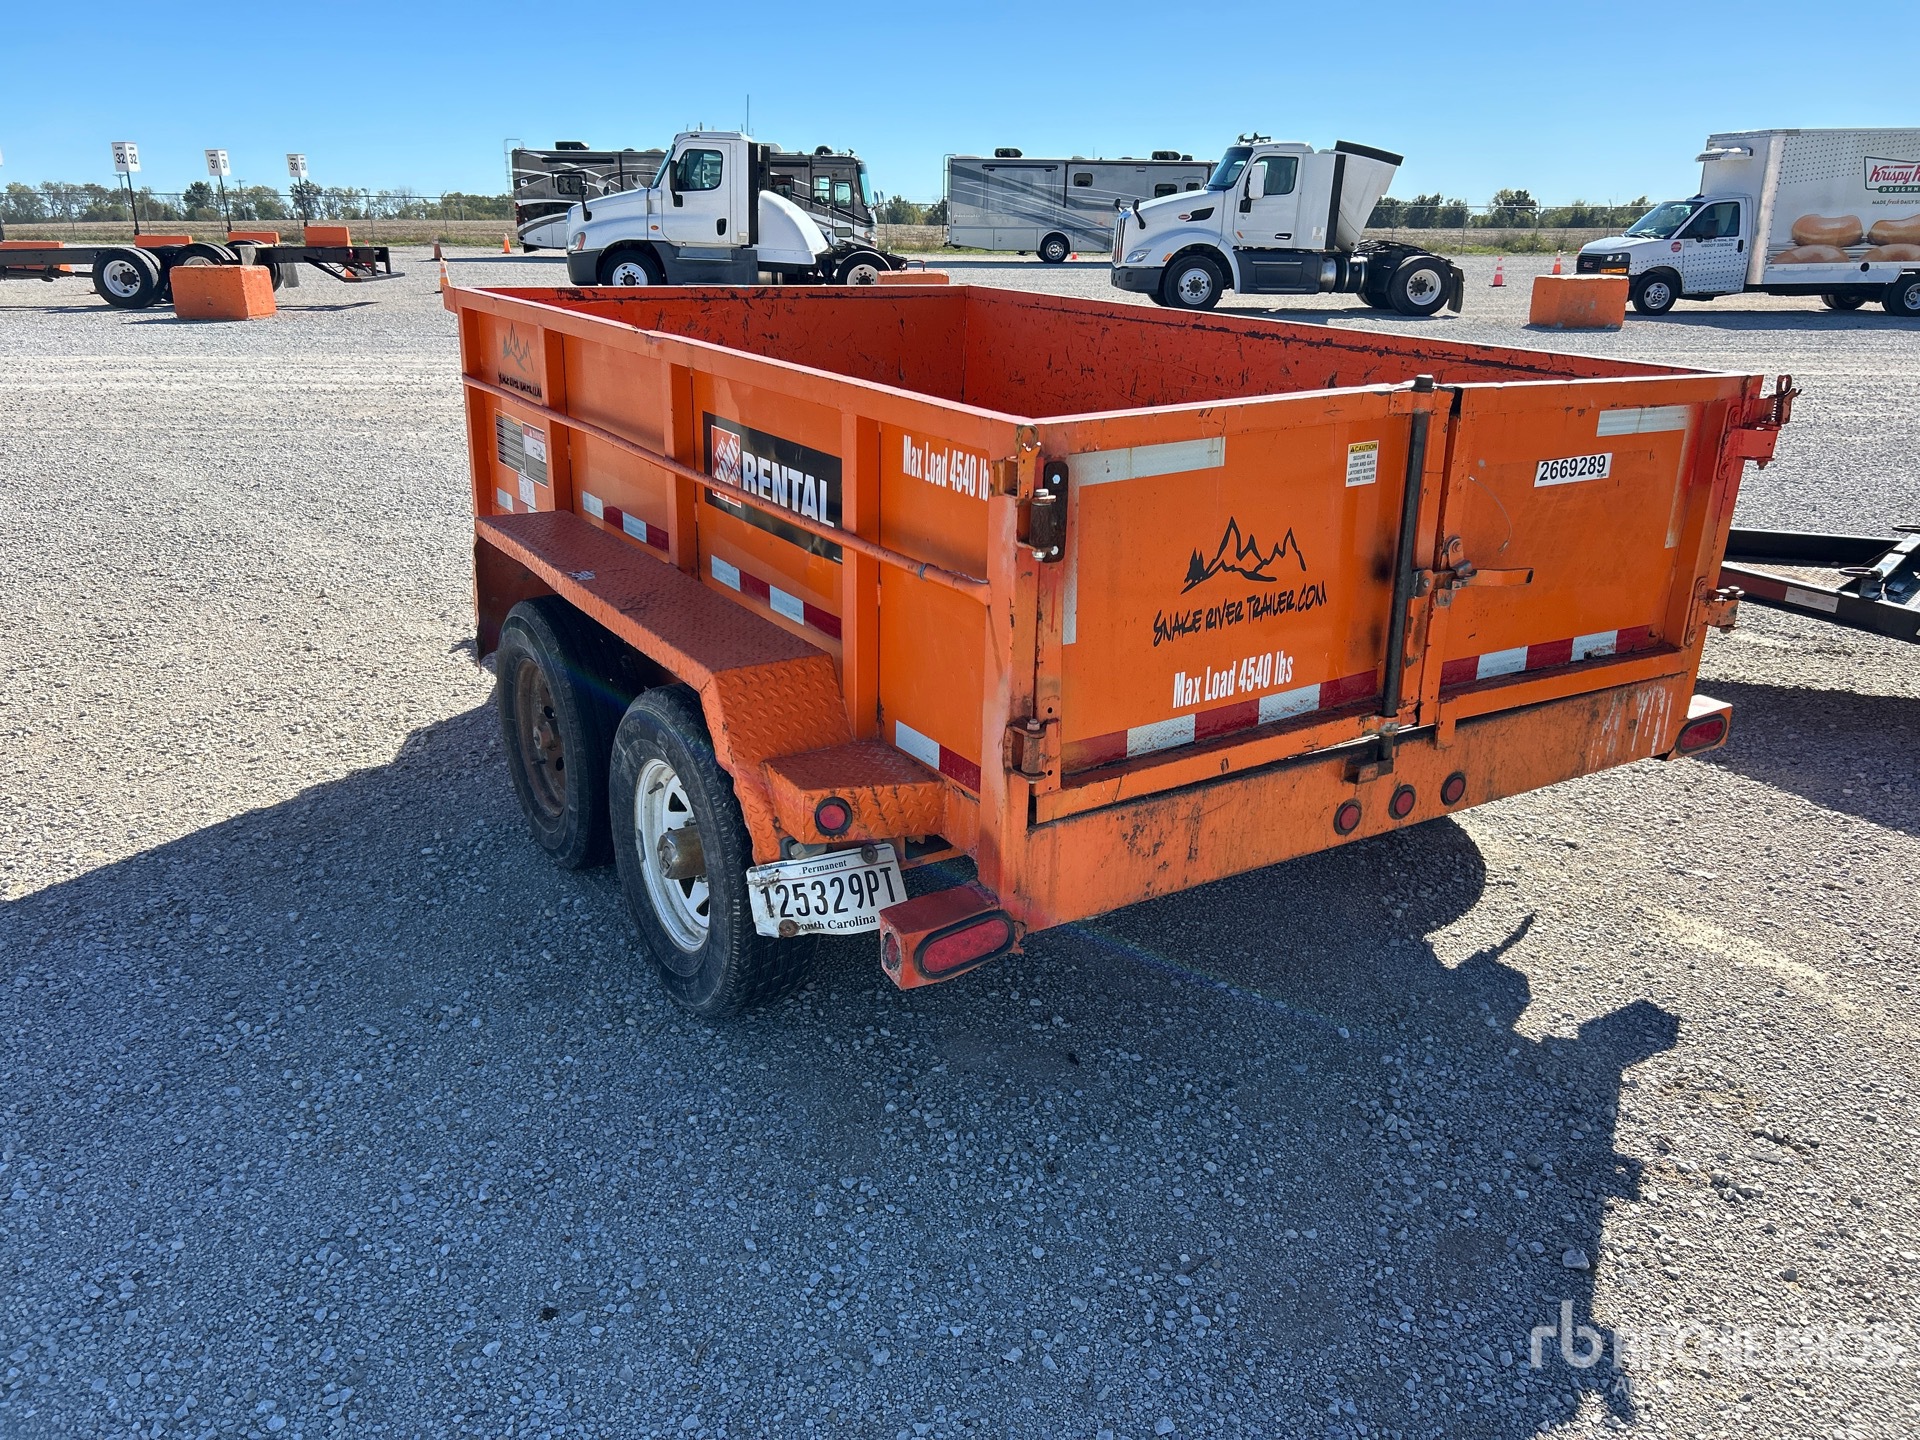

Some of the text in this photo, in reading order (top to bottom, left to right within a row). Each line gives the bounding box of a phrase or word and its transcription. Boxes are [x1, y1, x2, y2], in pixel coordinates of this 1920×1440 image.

[115, 152, 126, 164] 32
[128, 153, 138, 165] 32
[210, 159, 219, 169] 31
[289, 161, 299, 171] 30
[1869, 165, 1916, 184] Krispy
[1355, 444, 1377, 452] CAUTION
[903, 434, 990, 502] Max Load 4540 lb
[1538, 454, 1607, 482] 2669289
[741, 450, 835, 528] RENTAL
[1153, 580, 1328, 648] SNAKE RIVER TRAILER.COM
[1172, 650, 1294, 709] Max Load 4540 lbs
[801, 859, 848, 875] Permanent
[760, 866, 896, 918] 125329PT
[827, 913, 877, 930] Carolina
